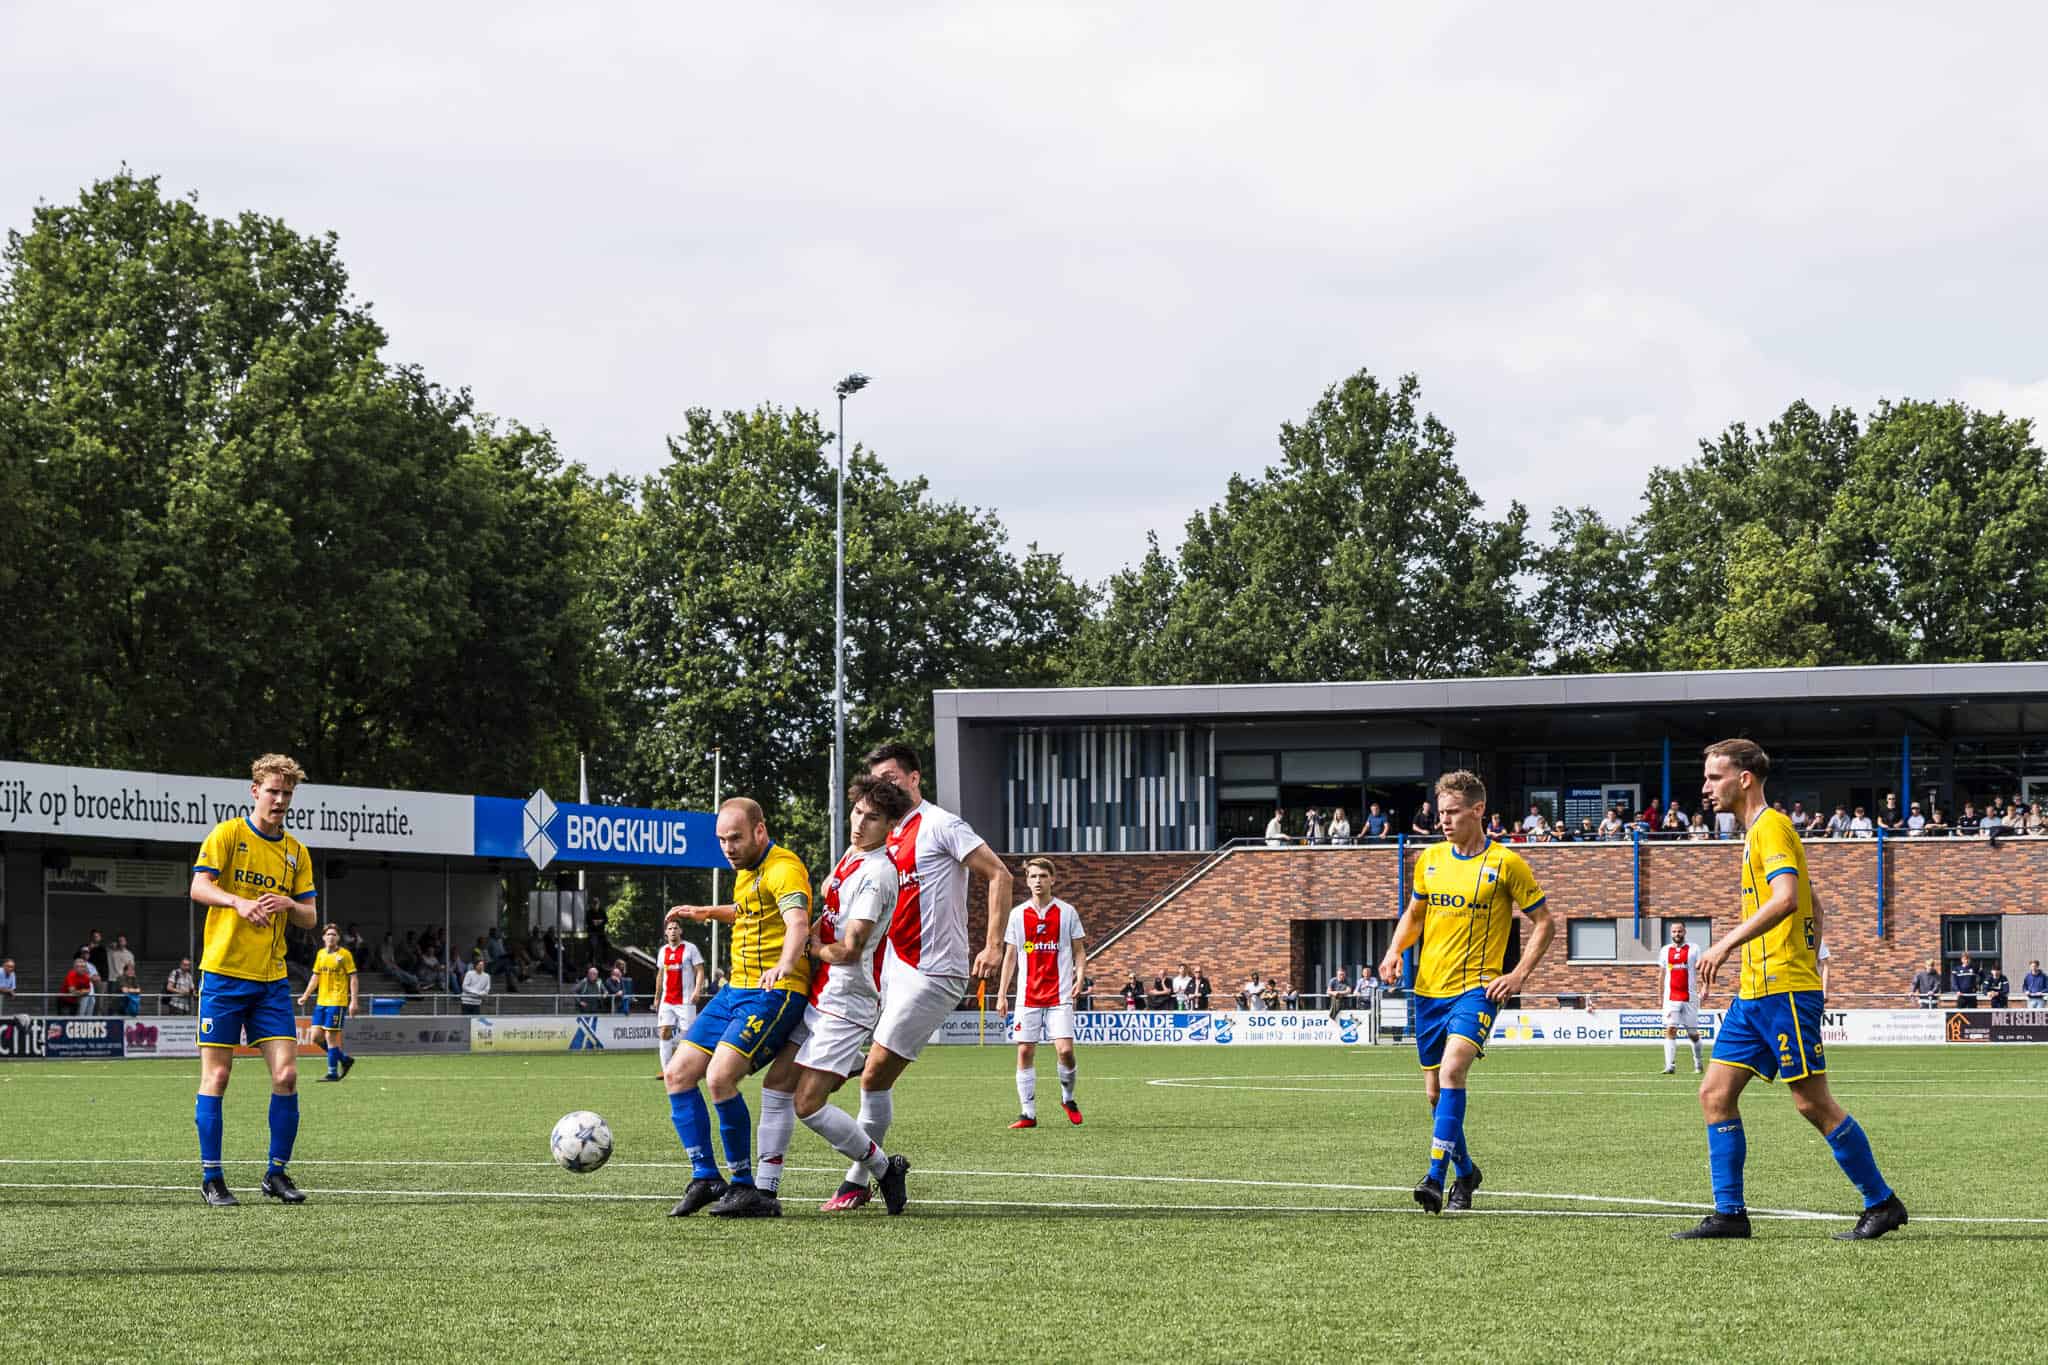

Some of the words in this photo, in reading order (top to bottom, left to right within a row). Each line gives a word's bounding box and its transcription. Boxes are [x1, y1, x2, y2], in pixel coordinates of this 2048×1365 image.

[39, 791, 67, 826] op
[73, 784, 207, 824] broekhuis.nl
[213, 802, 256, 823] voo
[280, 808, 315, 831] eer
[320, 801, 413, 841] inspiratie.
[567, 815, 687, 855] BROEKHUIS
[234, 869, 276, 888] REBO
[1427, 893, 1466, 908] EBO
[65, 1021, 108, 1039] GEURTS
[746, 1014, 764, 1034] 14
[1093, 1015, 1114, 1028] LID
[1120, 1015, 1149, 1028] VAN
[1154, 1015, 1174, 1028] DE
[1248, 1016, 1276, 1027] SDC
[1281, 1016, 1298, 1027] 60
[1302, 1016, 1329, 1030] jaar
[1074, 1029, 1104, 1042] VAN
[1109, 1029, 1183, 1042] HONDERD
[1553, 1026, 1572, 1040] de
[1577, 1026, 1614, 1040] Boer
[1777, 1034, 1790, 1051] 2
